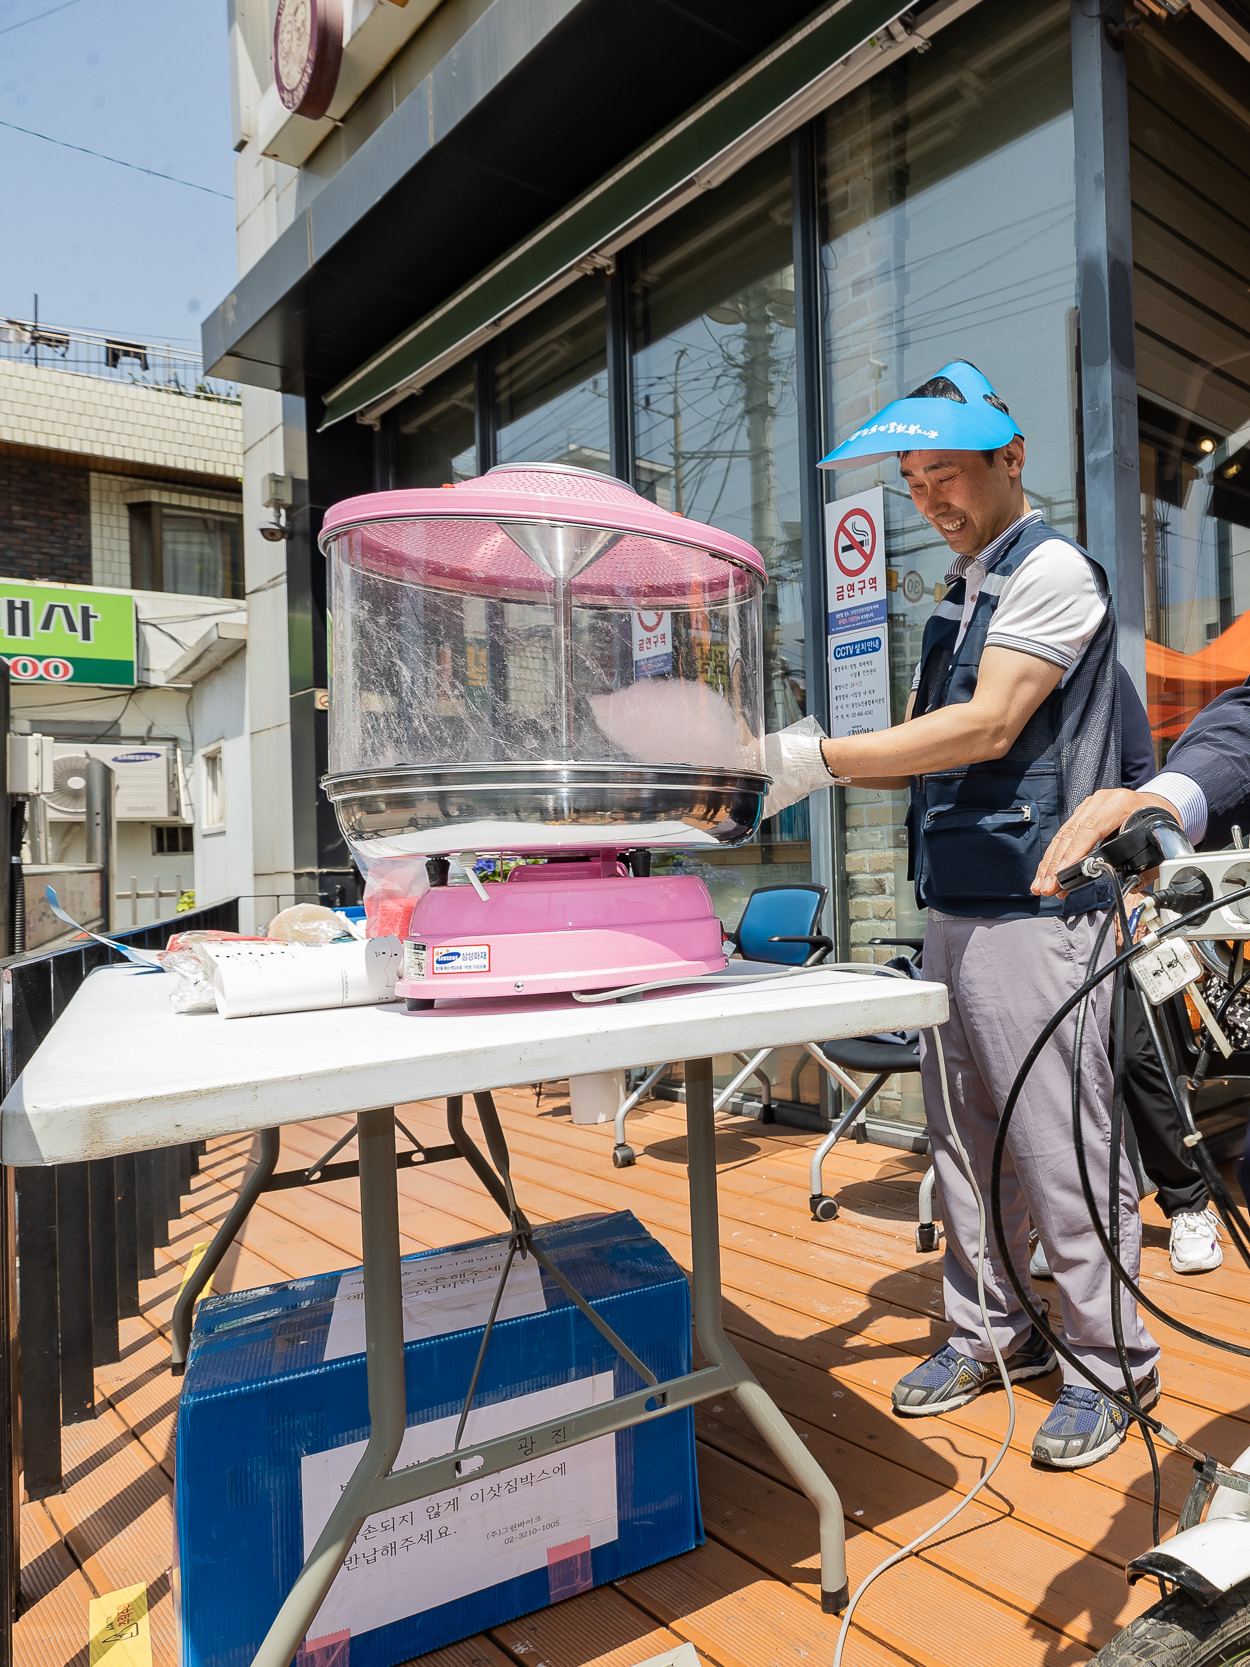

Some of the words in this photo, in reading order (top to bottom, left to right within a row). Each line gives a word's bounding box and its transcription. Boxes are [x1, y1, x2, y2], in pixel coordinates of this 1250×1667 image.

[836, 576, 878, 602] 금연구역
[462, 951, 487, 962] 삼성화재
[353, 1511, 414, 1544] 손되지
[425, 1497, 460, 1520] 않게
[470, 1462, 567, 1504] 이삿짐박스에
[504, 1519, 560, 1545] 02-3210-1005
[343, 1525, 458, 1571] 반납해주세요.
